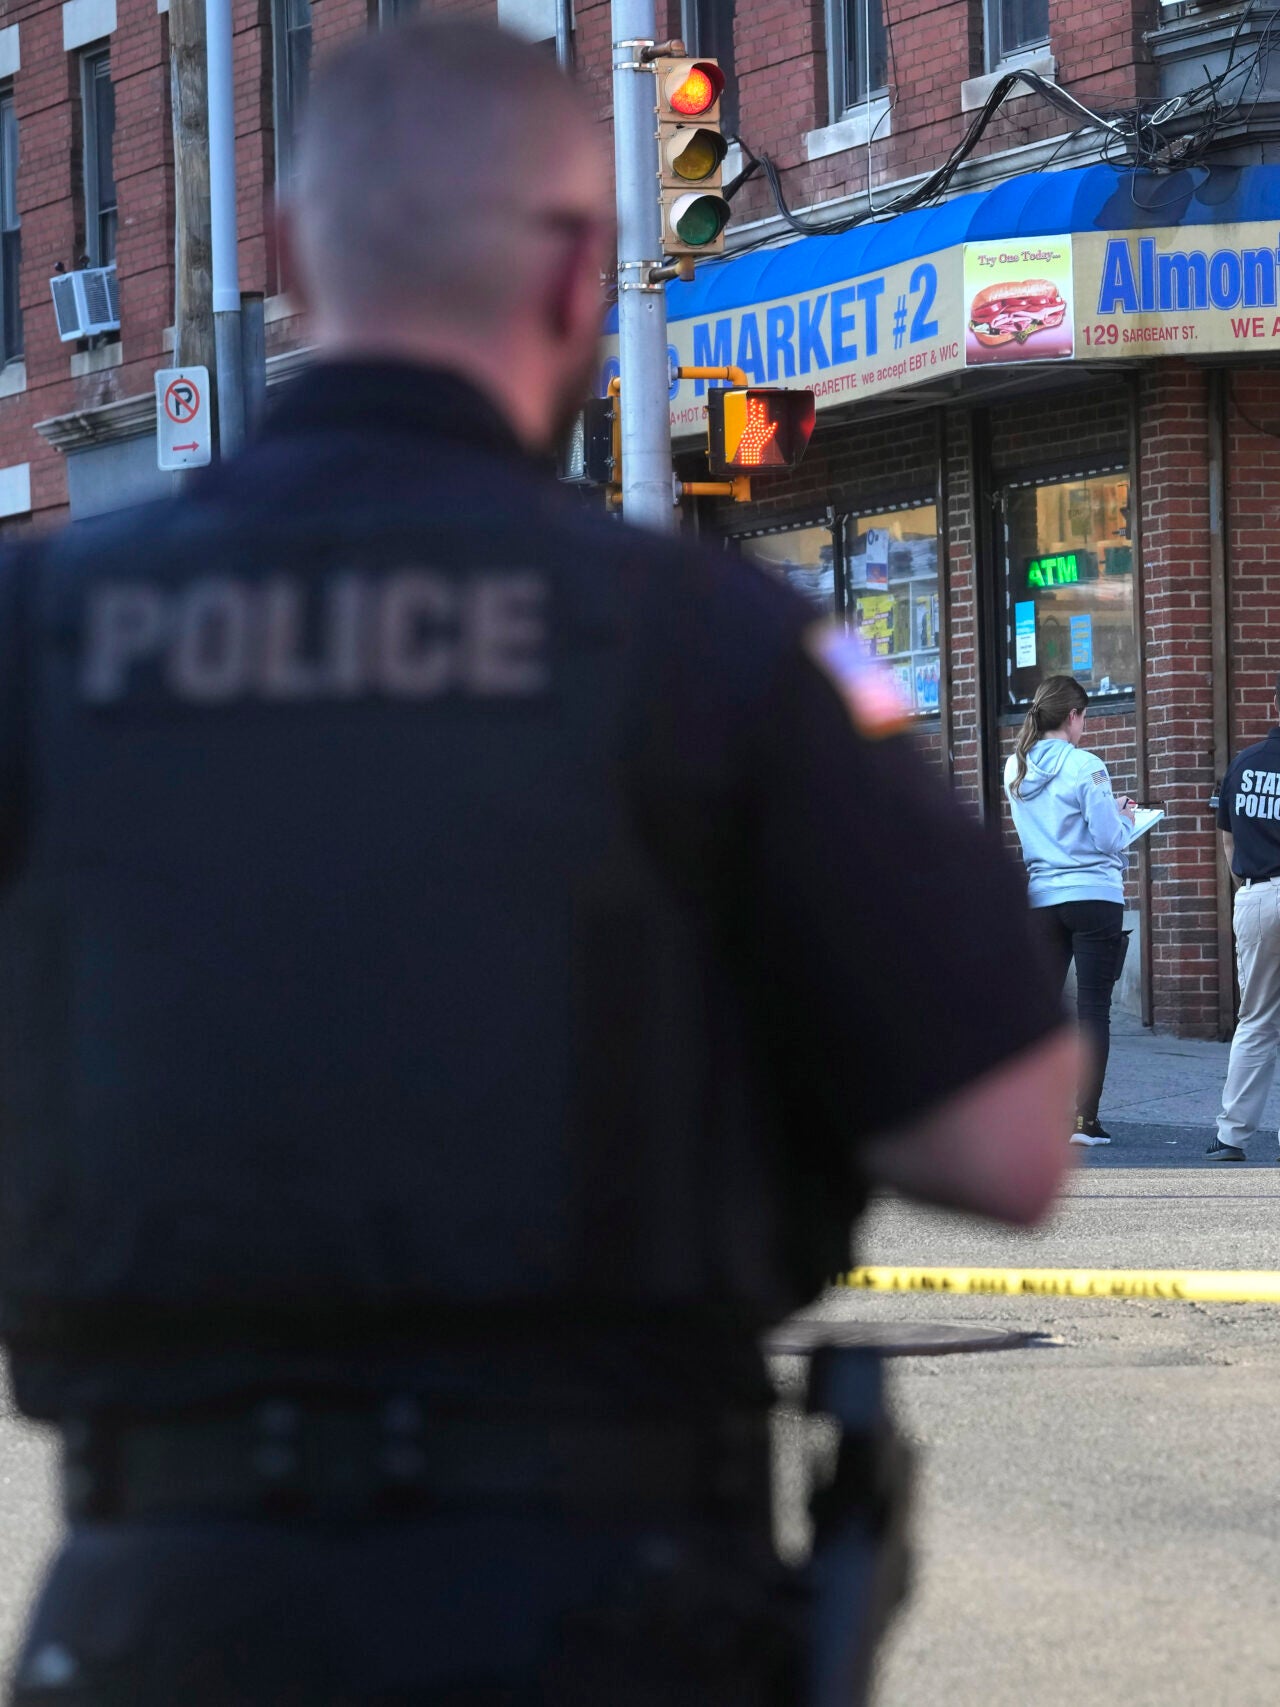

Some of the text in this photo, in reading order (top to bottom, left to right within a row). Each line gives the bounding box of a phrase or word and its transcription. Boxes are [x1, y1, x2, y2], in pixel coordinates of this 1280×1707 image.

[977, 249, 1061, 267] Try One Today...
[693, 276, 884, 397] MARKET
[892, 262, 938, 350] #2
[1082, 323, 1198, 345] 129 SARGEANT ST.
[1230, 317, 1266, 338] WE
[681, 405, 699, 425] HOT
[861, 374, 875, 386] we
[877, 359, 907, 382] accept
[909, 351, 928, 373] EBT
[930, 350, 937, 365] &
[939, 342, 959, 364] WIC
[1028, 554, 1078, 588] ATM
[83, 570, 547, 700] POLICE
